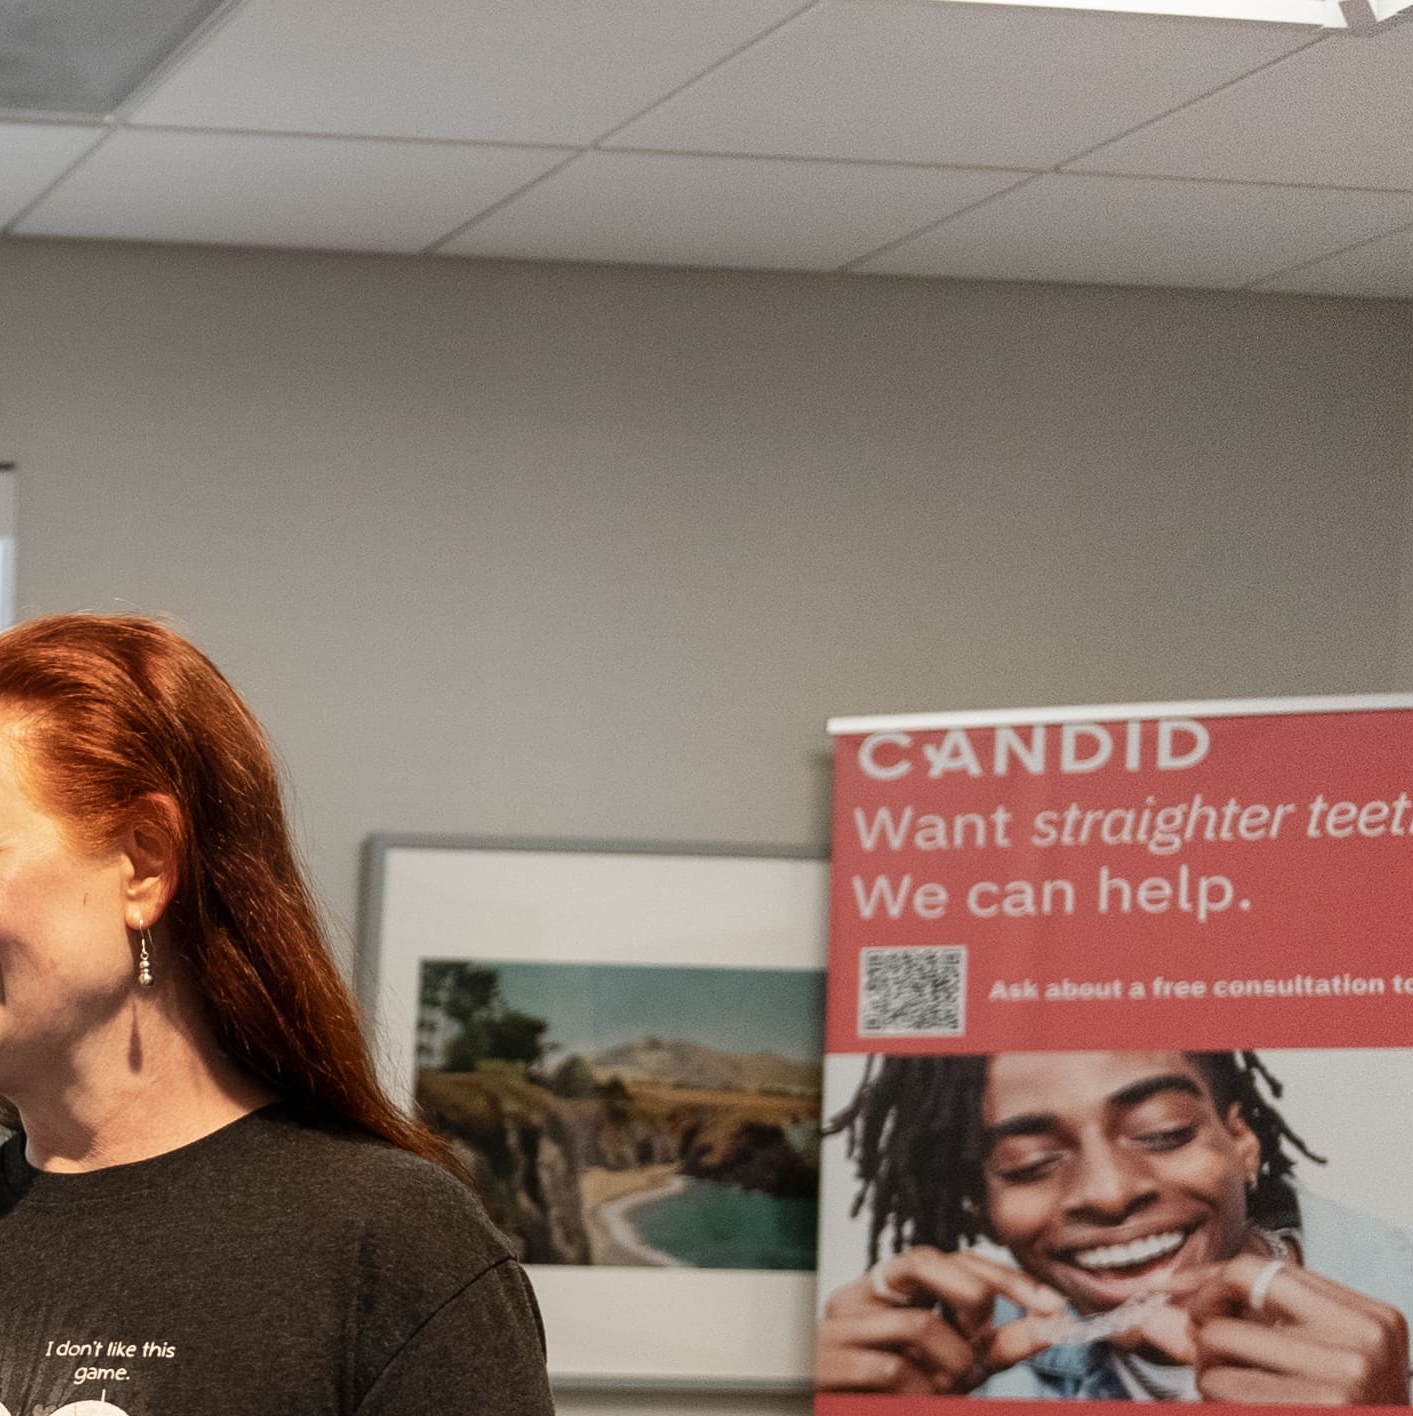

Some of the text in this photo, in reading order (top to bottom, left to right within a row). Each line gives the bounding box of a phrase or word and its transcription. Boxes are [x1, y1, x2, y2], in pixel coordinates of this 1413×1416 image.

[857, 718, 1211, 780] CANDID
[853, 792, 1413, 856] Want straighter teet
[852, 864, 1252, 923] We can help.
[989, 978, 1039, 1001] Ask
[1044, 977, 1122, 1001] about
[1128, 980, 1146, 999] a
[1152, 976, 1207, 999] free
[1213, 973, 1385, 998] consultation
[45, 1340, 176, 1358] I don't like this
[73, 1366, 130, 1385] game.
